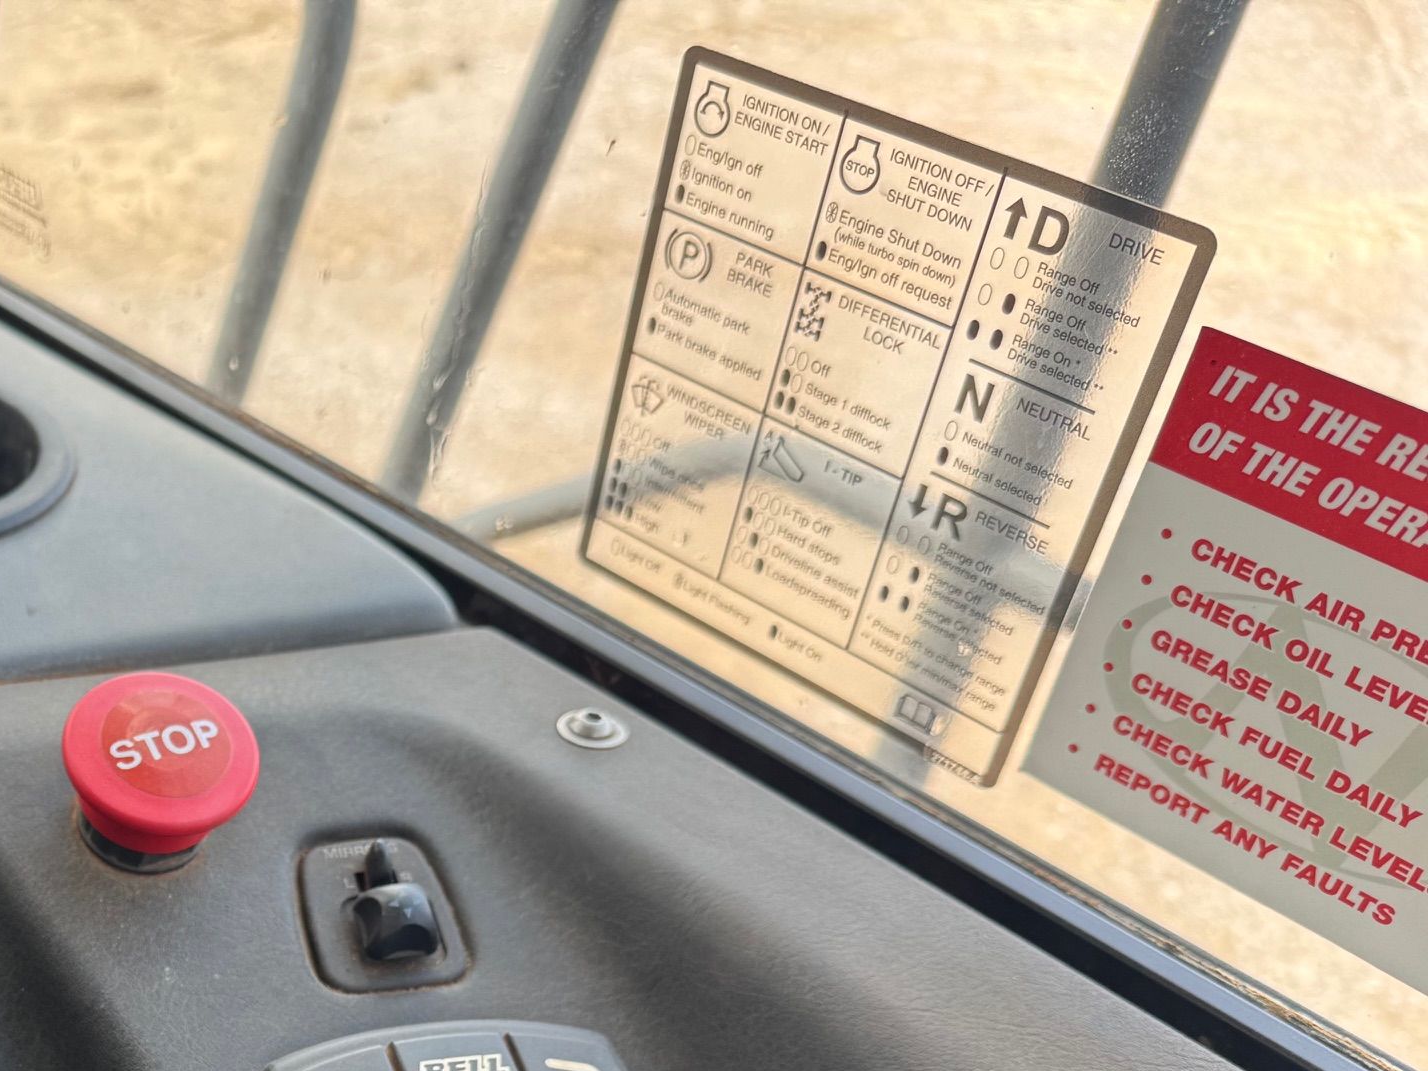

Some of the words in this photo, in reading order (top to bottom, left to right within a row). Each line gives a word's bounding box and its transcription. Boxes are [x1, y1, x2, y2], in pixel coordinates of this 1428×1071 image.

[734, 111, 783, 139] ENGINE
[784, 130, 829, 156] START
[742, 94, 799, 126] IGNITION
[801, 116, 822, 134] ON
[697, 142, 743, 172] Eng/Ign
[745, 163, 763, 178] off
[845, 159, 875, 178] STOP
[890, 148, 953, 183] IGNITION
[954, 173, 985, 193] OFF
[691, 167, 734, 196] Ignition
[736, 189, 752, 202] on
[907, 176, 963, 207] ENGINE
[685, 192, 727, 219] Engine
[728, 211, 775, 241] running
[886, 188, 926, 213] SHUT
[926, 204, 972, 232] DOWN
[679, 240, 699, 270] P
[834, 226, 865, 250] (while
[867, 242, 895, 262] turbo
[896, 255, 920, 272] spin
[921, 264, 956, 289] down)
[839, 209, 884, 239] Engine
[887, 229, 920, 253] Shut
[922, 242, 962, 270] Down
[1028, 205, 1070, 256] D
[1108, 233, 1165, 266] DRIVE
[726, 268, 773, 298] BRAKE
[735, 251, 774, 278] PARK
[828, 248, 877, 279] Eng/Ign
[881, 272, 900, 288] off
[901, 280, 953, 310] request
[1037, 261, 1076, 287] Range
[1080, 278, 1100, 296] Off
[661, 303, 694, 327] brake
[664, 288, 722, 323] Automatic
[721, 315, 751, 336] park
[838, 295, 941, 350] DIFFERENTIAL
[1024, 298, 1063, 323] Range
[1067, 315, 1086, 331] Off
[1032, 276, 1063, 298] Drive
[1066, 290, 1086, 308] not
[1088, 300, 1141, 328] selected
[655, 324, 683, 344] Park
[684, 336, 717, 361] brake
[719, 355, 762, 381] applied
[863, 326, 905, 355] LOCK
[1012, 334, 1050, 358] Range
[1053, 351, 1071, 367] On
[1019, 312, 1050, 333] Drive
[1052, 326, 1105, 356] selected
[811, 360, 832, 378] Off
[1007, 348, 1037, 369] Drive
[1039, 361, 1091, 391] selected
[667, 384, 752, 435] WINDSCREEN
[805, 382, 837, 407] Stage
[841, 399, 848, 410] 1
[850, 402, 891, 430] difflock
[953, 373, 995, 424] N
[1016, 397, 1091, 441] NEUTRAL
[1209, 364, 1258, 404] IT
[1250, 382, 1300, 422] IS
[1298, 399, 1382, 456] THE
[683, 411, 724, 441] WIPER
[797, 405, 829, 429] Stage
[831, 423, 840, 434] 2
[842, 427, 883, 454] difflock
[841, 466, 863, 486] TIP
[953, 457, 993, 483] Neutral
[994, 478, 1043, 506] selected
[962, 431, 1002, 457] Neutral
[1003, 453, 1022, 468] not
[1024, 461, 1074, 490] selected
[1188, 422, 1246, 461] OF
[1241, 441, 1322, 497] THE
[811, 521, 832, 537] Off
[930, 492, 968, 541] R
[974, 511, 1050, 555] REVERSE
[777, 525, 807, 548] Hard
[809, 543, 842, 566] stops
[937, 542, 973, 566] Range
[975, 561, 994, 576] Off
[765, 564, 852, 621] Loadspreading
[772, 545, 822, 581] Driveline
[824, 575, 861, 599] assist
[1191, 538, 1303, 604] CHECK
[1304, 592, 1366, 633] AIR
[964, 591, 983, 606] Off
[978, 578, 997, 593] not
[999, 587, 1045, 616] selected
[1170, 585, 1280, 650] CHECK
[1285, 639, 1335, 679] OIL
[1344, 665, 1428, 725] LEVE
[1150, 629, 1273, 702] GREASE
[1275, 690, 1374, 748] DAILY
[108, 719, 219, 771] STOP
[1131, 673, 1236, 738] CHECK
[1238, 726, 1317, 781] FUEL
[1325, 769, 1423, 829] DAILY
[1112, 715, 1215, 779] CHECK
[1221, 767, 1325, 838] WATER
[1329, 826, 1428, 893] LEVEL
[1093, 754, 1210, 825] REPORT
[1211, 819, 1278, 860] ANY
[1280, 852, 1397, 926] FAULTS
